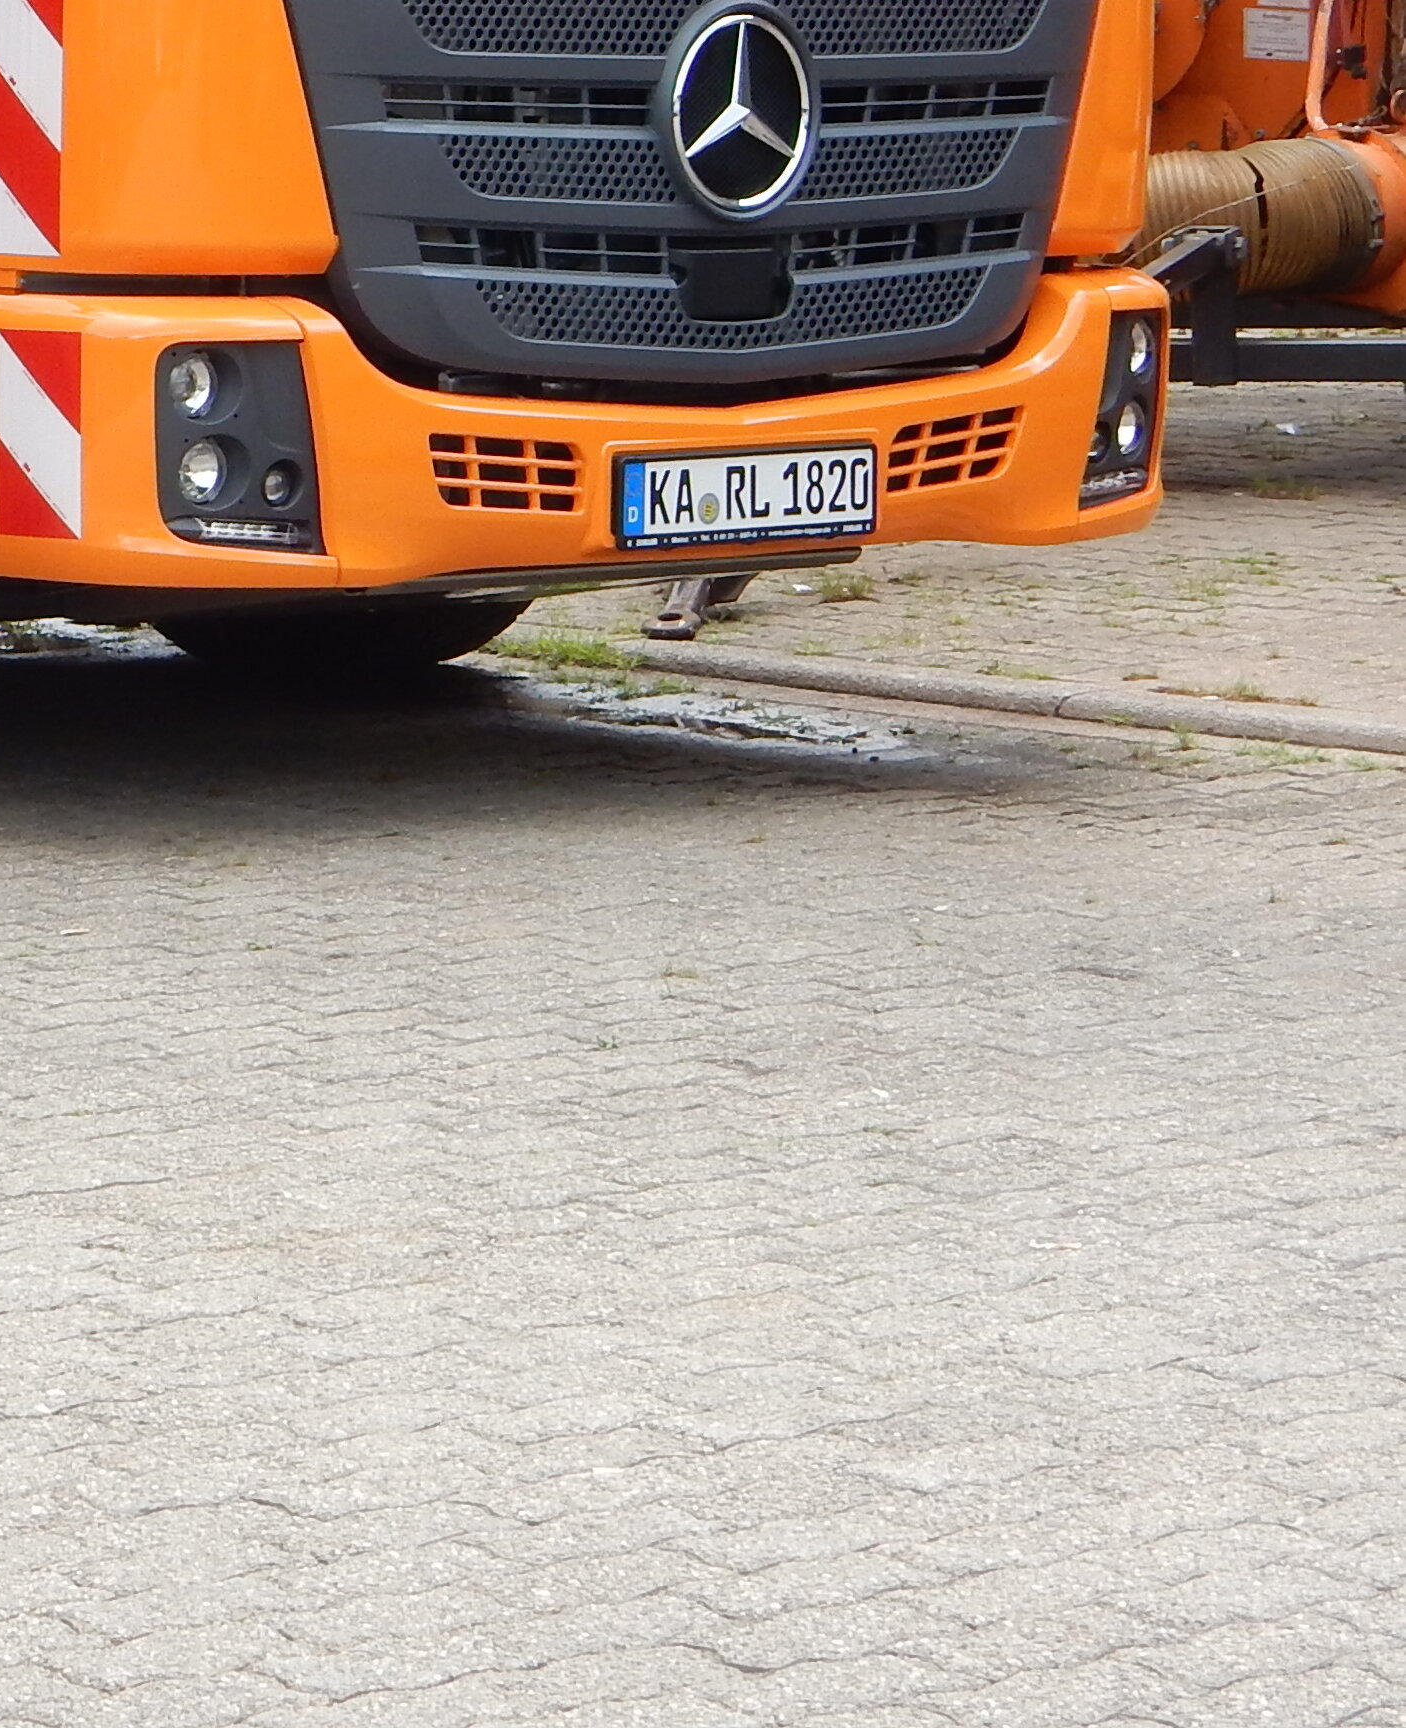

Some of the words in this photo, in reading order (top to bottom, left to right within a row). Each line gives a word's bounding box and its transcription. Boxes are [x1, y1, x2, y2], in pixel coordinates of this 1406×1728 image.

[650, 468, 695, 526] KA
[726, 464, 770, 520] RL
[782, 457, 869, 516] 1820
[628, 506, 639, 523] D
